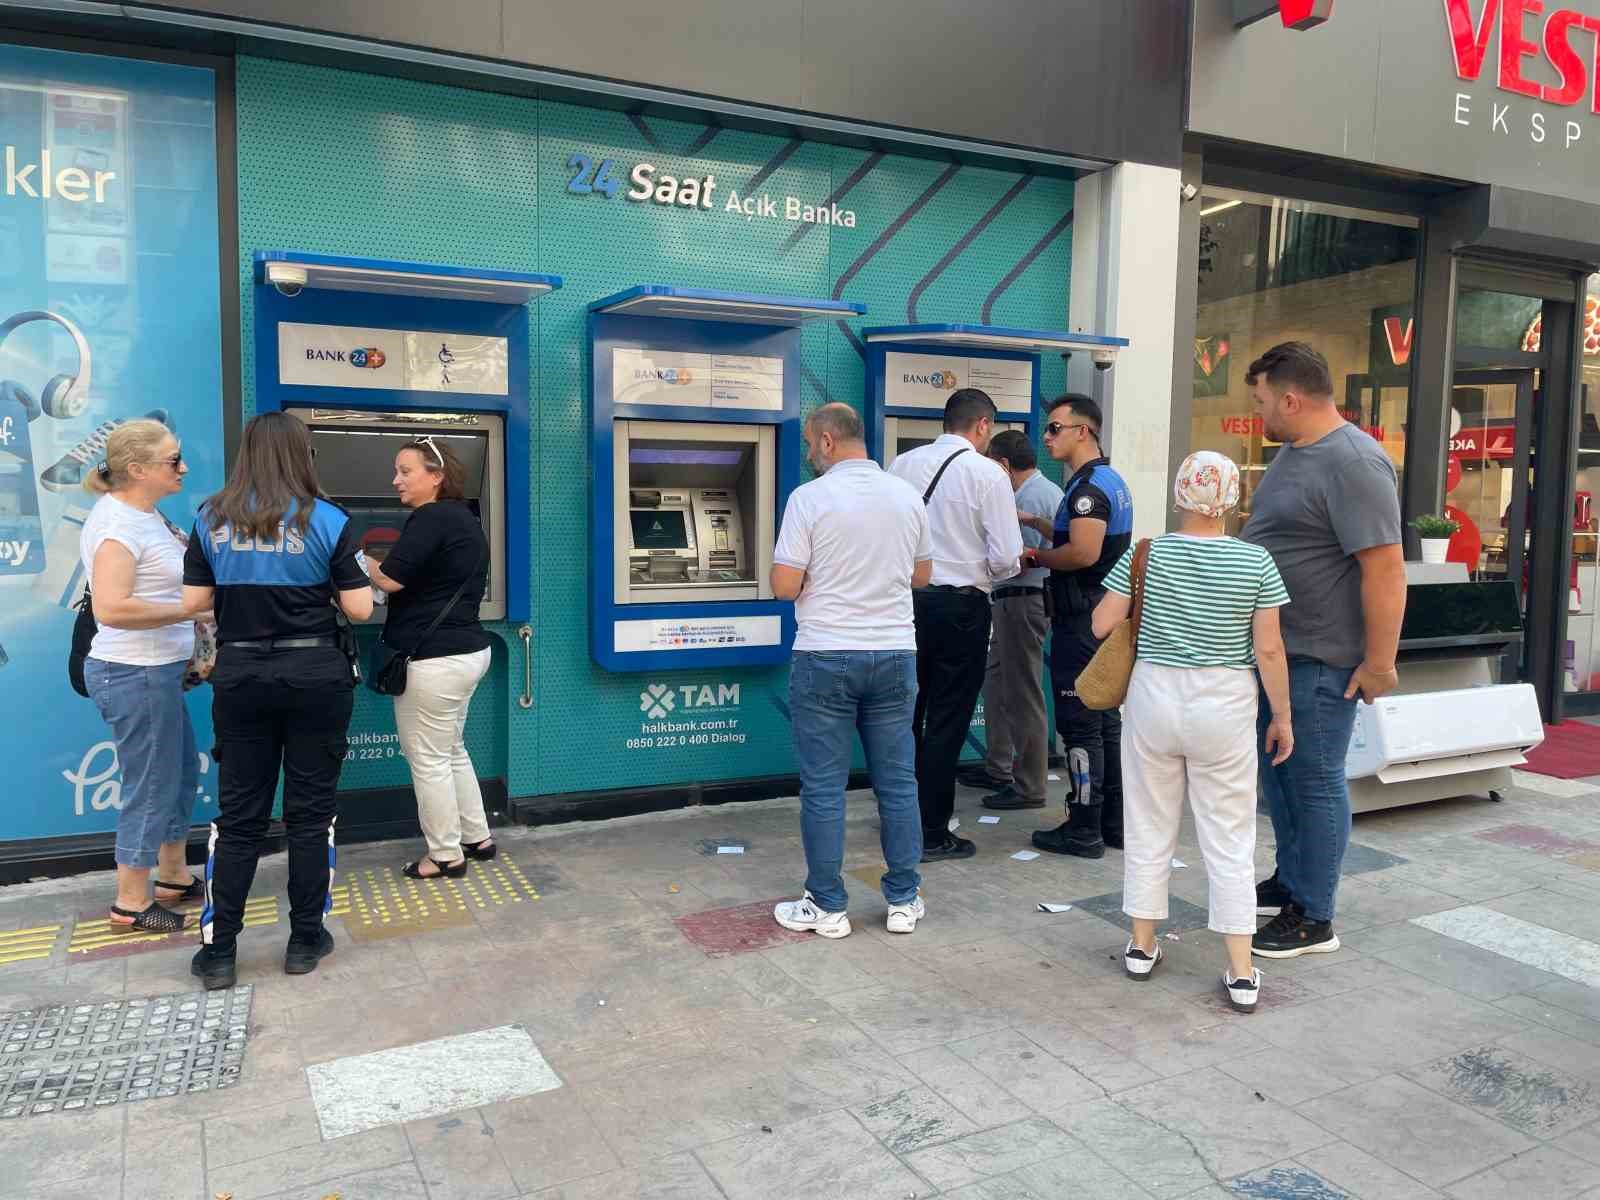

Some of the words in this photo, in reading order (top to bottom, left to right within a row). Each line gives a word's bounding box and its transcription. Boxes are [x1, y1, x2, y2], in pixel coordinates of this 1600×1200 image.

[6, 146, 115, 203] kler
[567, 153, 617, 199] 24
[628, 163, 716, 208] Saat
[725, 190, 777, 221] Açık
[784, 197, 856, 228] Banka
[306, 349, 346, 362] BANK
[634, 369, 664, 380] BANK
[903, 373, 930, 385] BANK
[680, 683, 740, 707] TAM
[642, 719, 738, 734] halkbank.com.tr
[626, 738, 653, 749] 0850
[656, 736, 676, 747] 222
[680, 736, 686, 745] 0
[689, 735, 708, 744] 400
[711, 733, 746, 744] Dialog
[360, 748, 383, 759] 222
